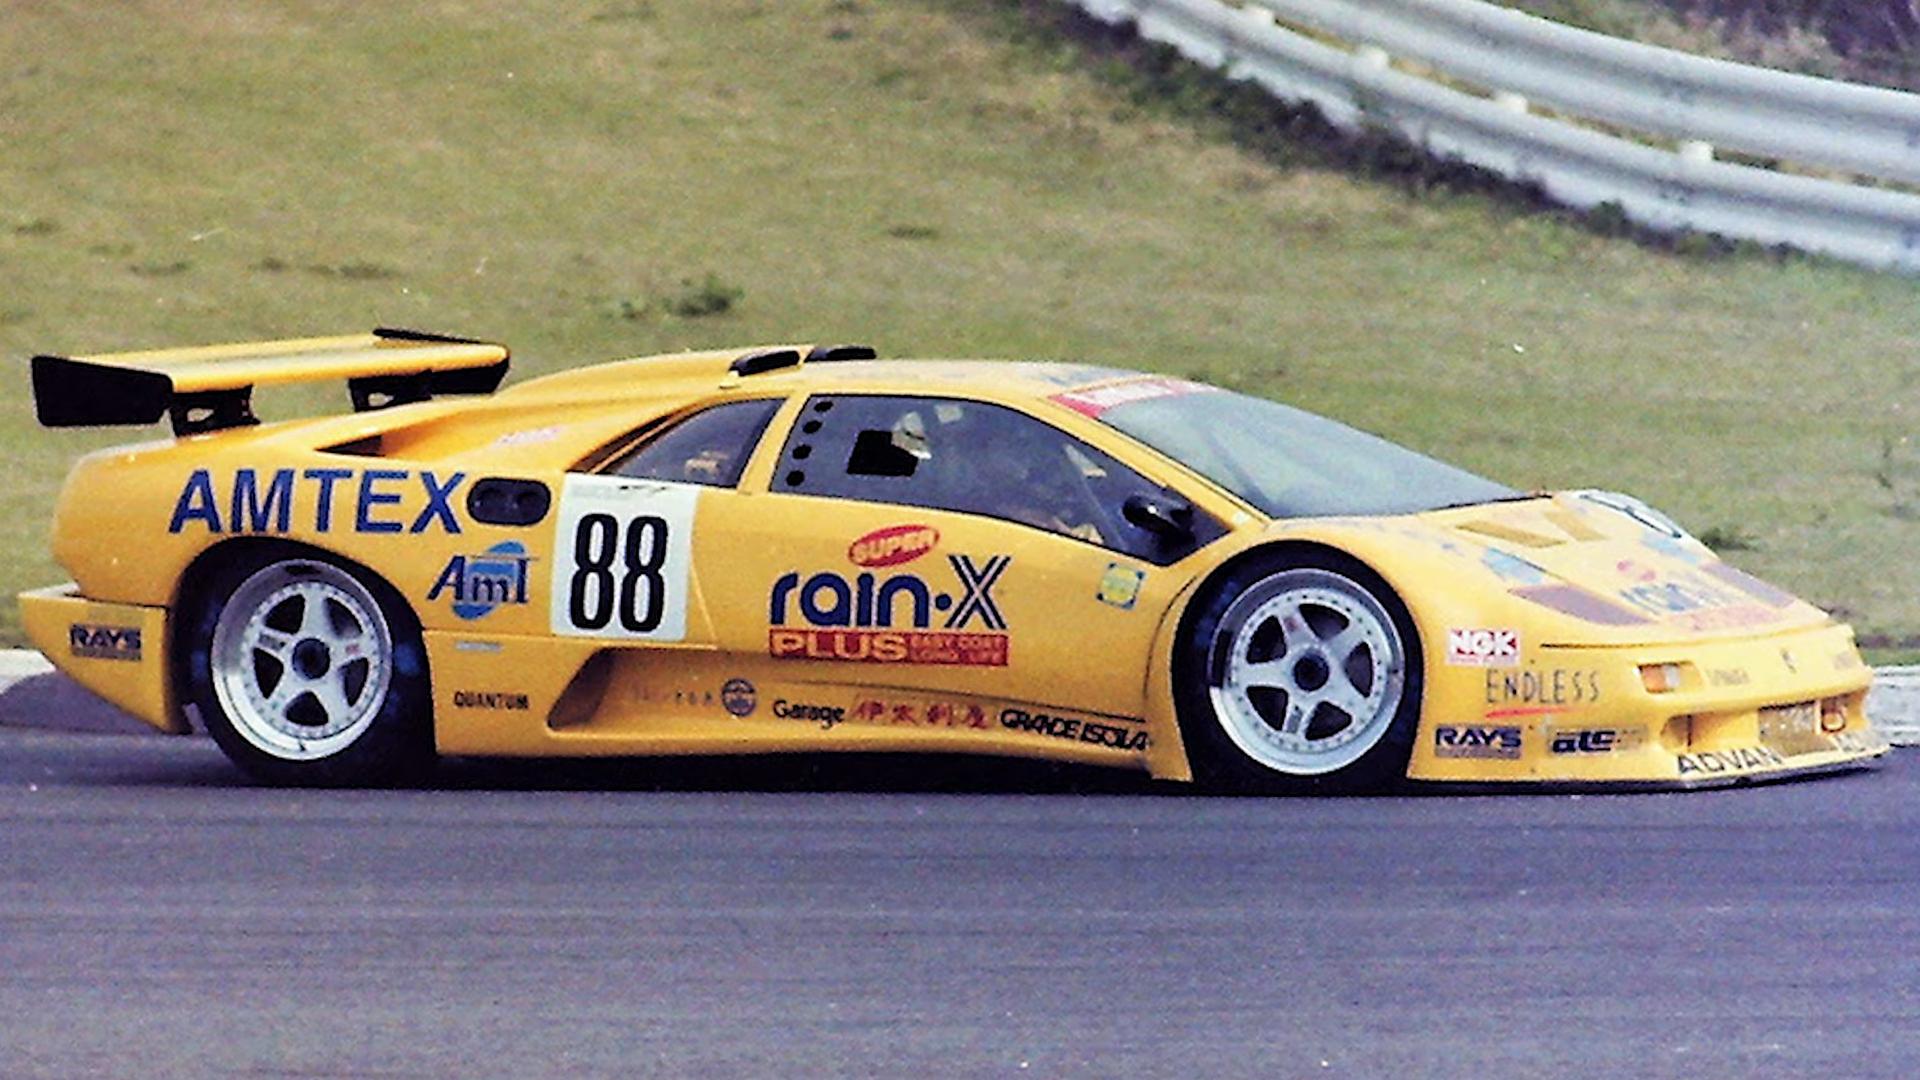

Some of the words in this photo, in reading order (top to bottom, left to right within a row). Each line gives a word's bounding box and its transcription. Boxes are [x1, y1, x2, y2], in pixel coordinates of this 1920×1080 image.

[168, 468, 467, 534] AMTEX
[852, 531, 934, 563] SUPER
[570, 513, 669, 633] 88
[70, 624, 141, 648] RAYS
[771, 632, 908, 661] PLUS
[1448, 629, 1518, 656] NGK
[454, 691, 529, 709] QUANTUM
[1486, 668, 1600, 703] ENDLESS
[773, 699, 844, 730] Garage
[1435, 728, 1521, 747] RAYS
[1676, 743, 1782, 776] ADVAN
